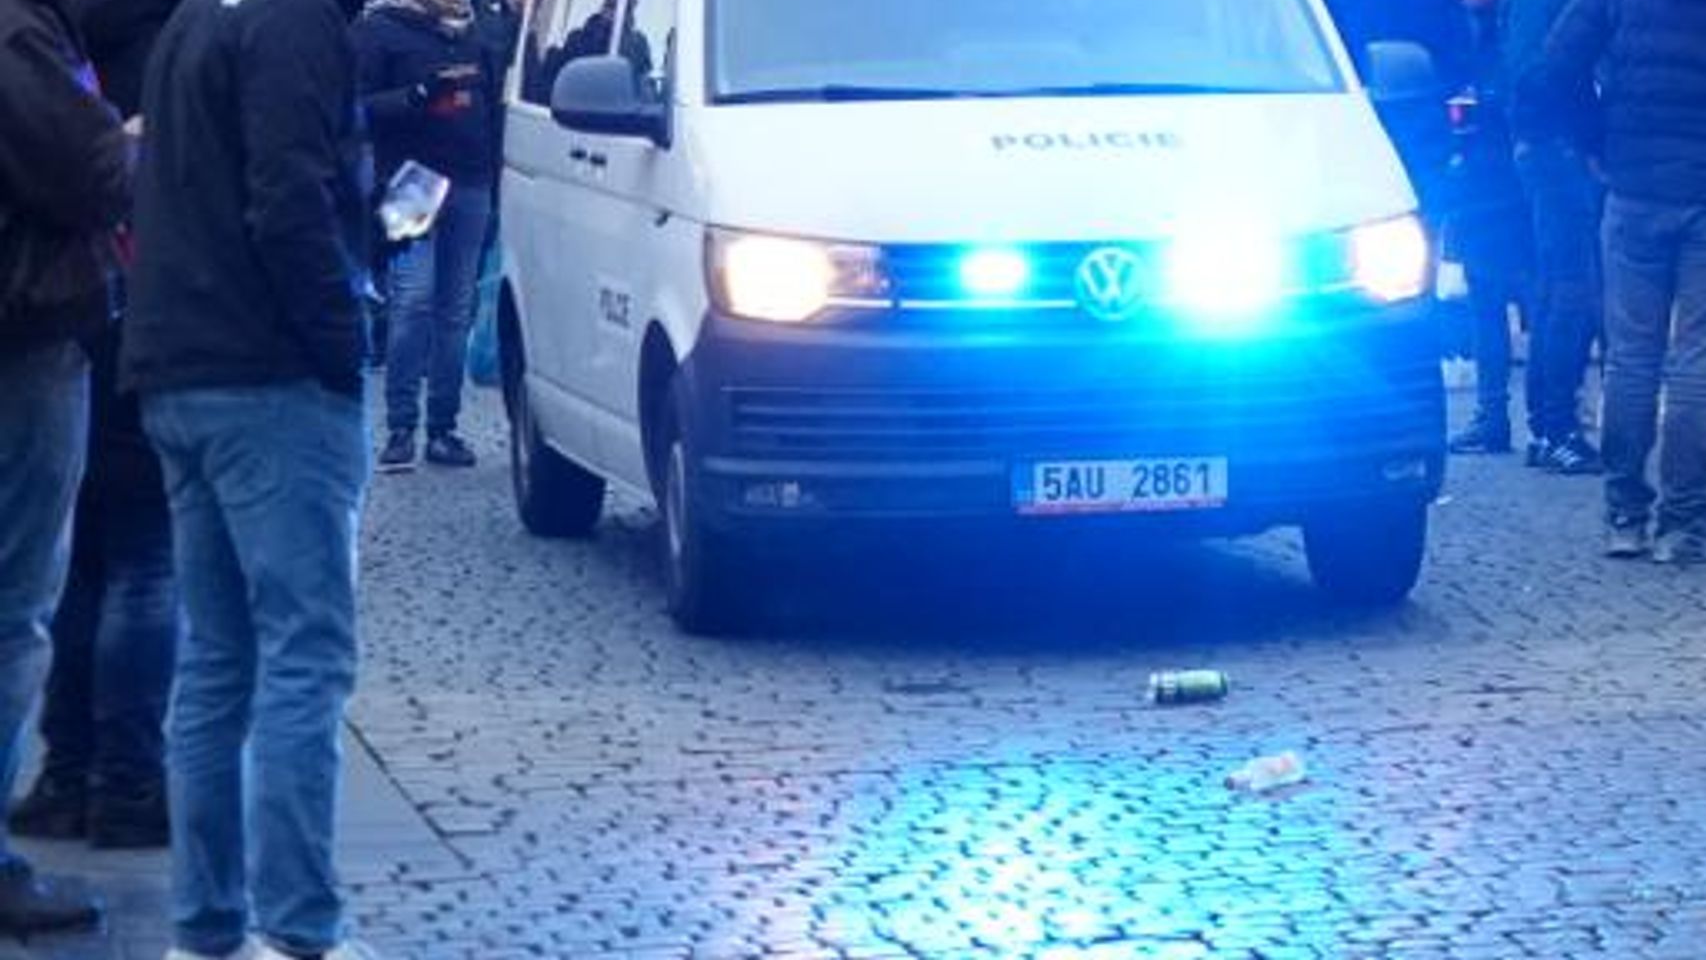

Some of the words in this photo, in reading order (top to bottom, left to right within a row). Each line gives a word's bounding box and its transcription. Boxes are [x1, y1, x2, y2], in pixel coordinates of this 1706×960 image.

[990, 132, 1182, 151] POLICIE
[1043, 466, 1105, 501] 5AU
[1131, 463, 1210, 500] 2861
